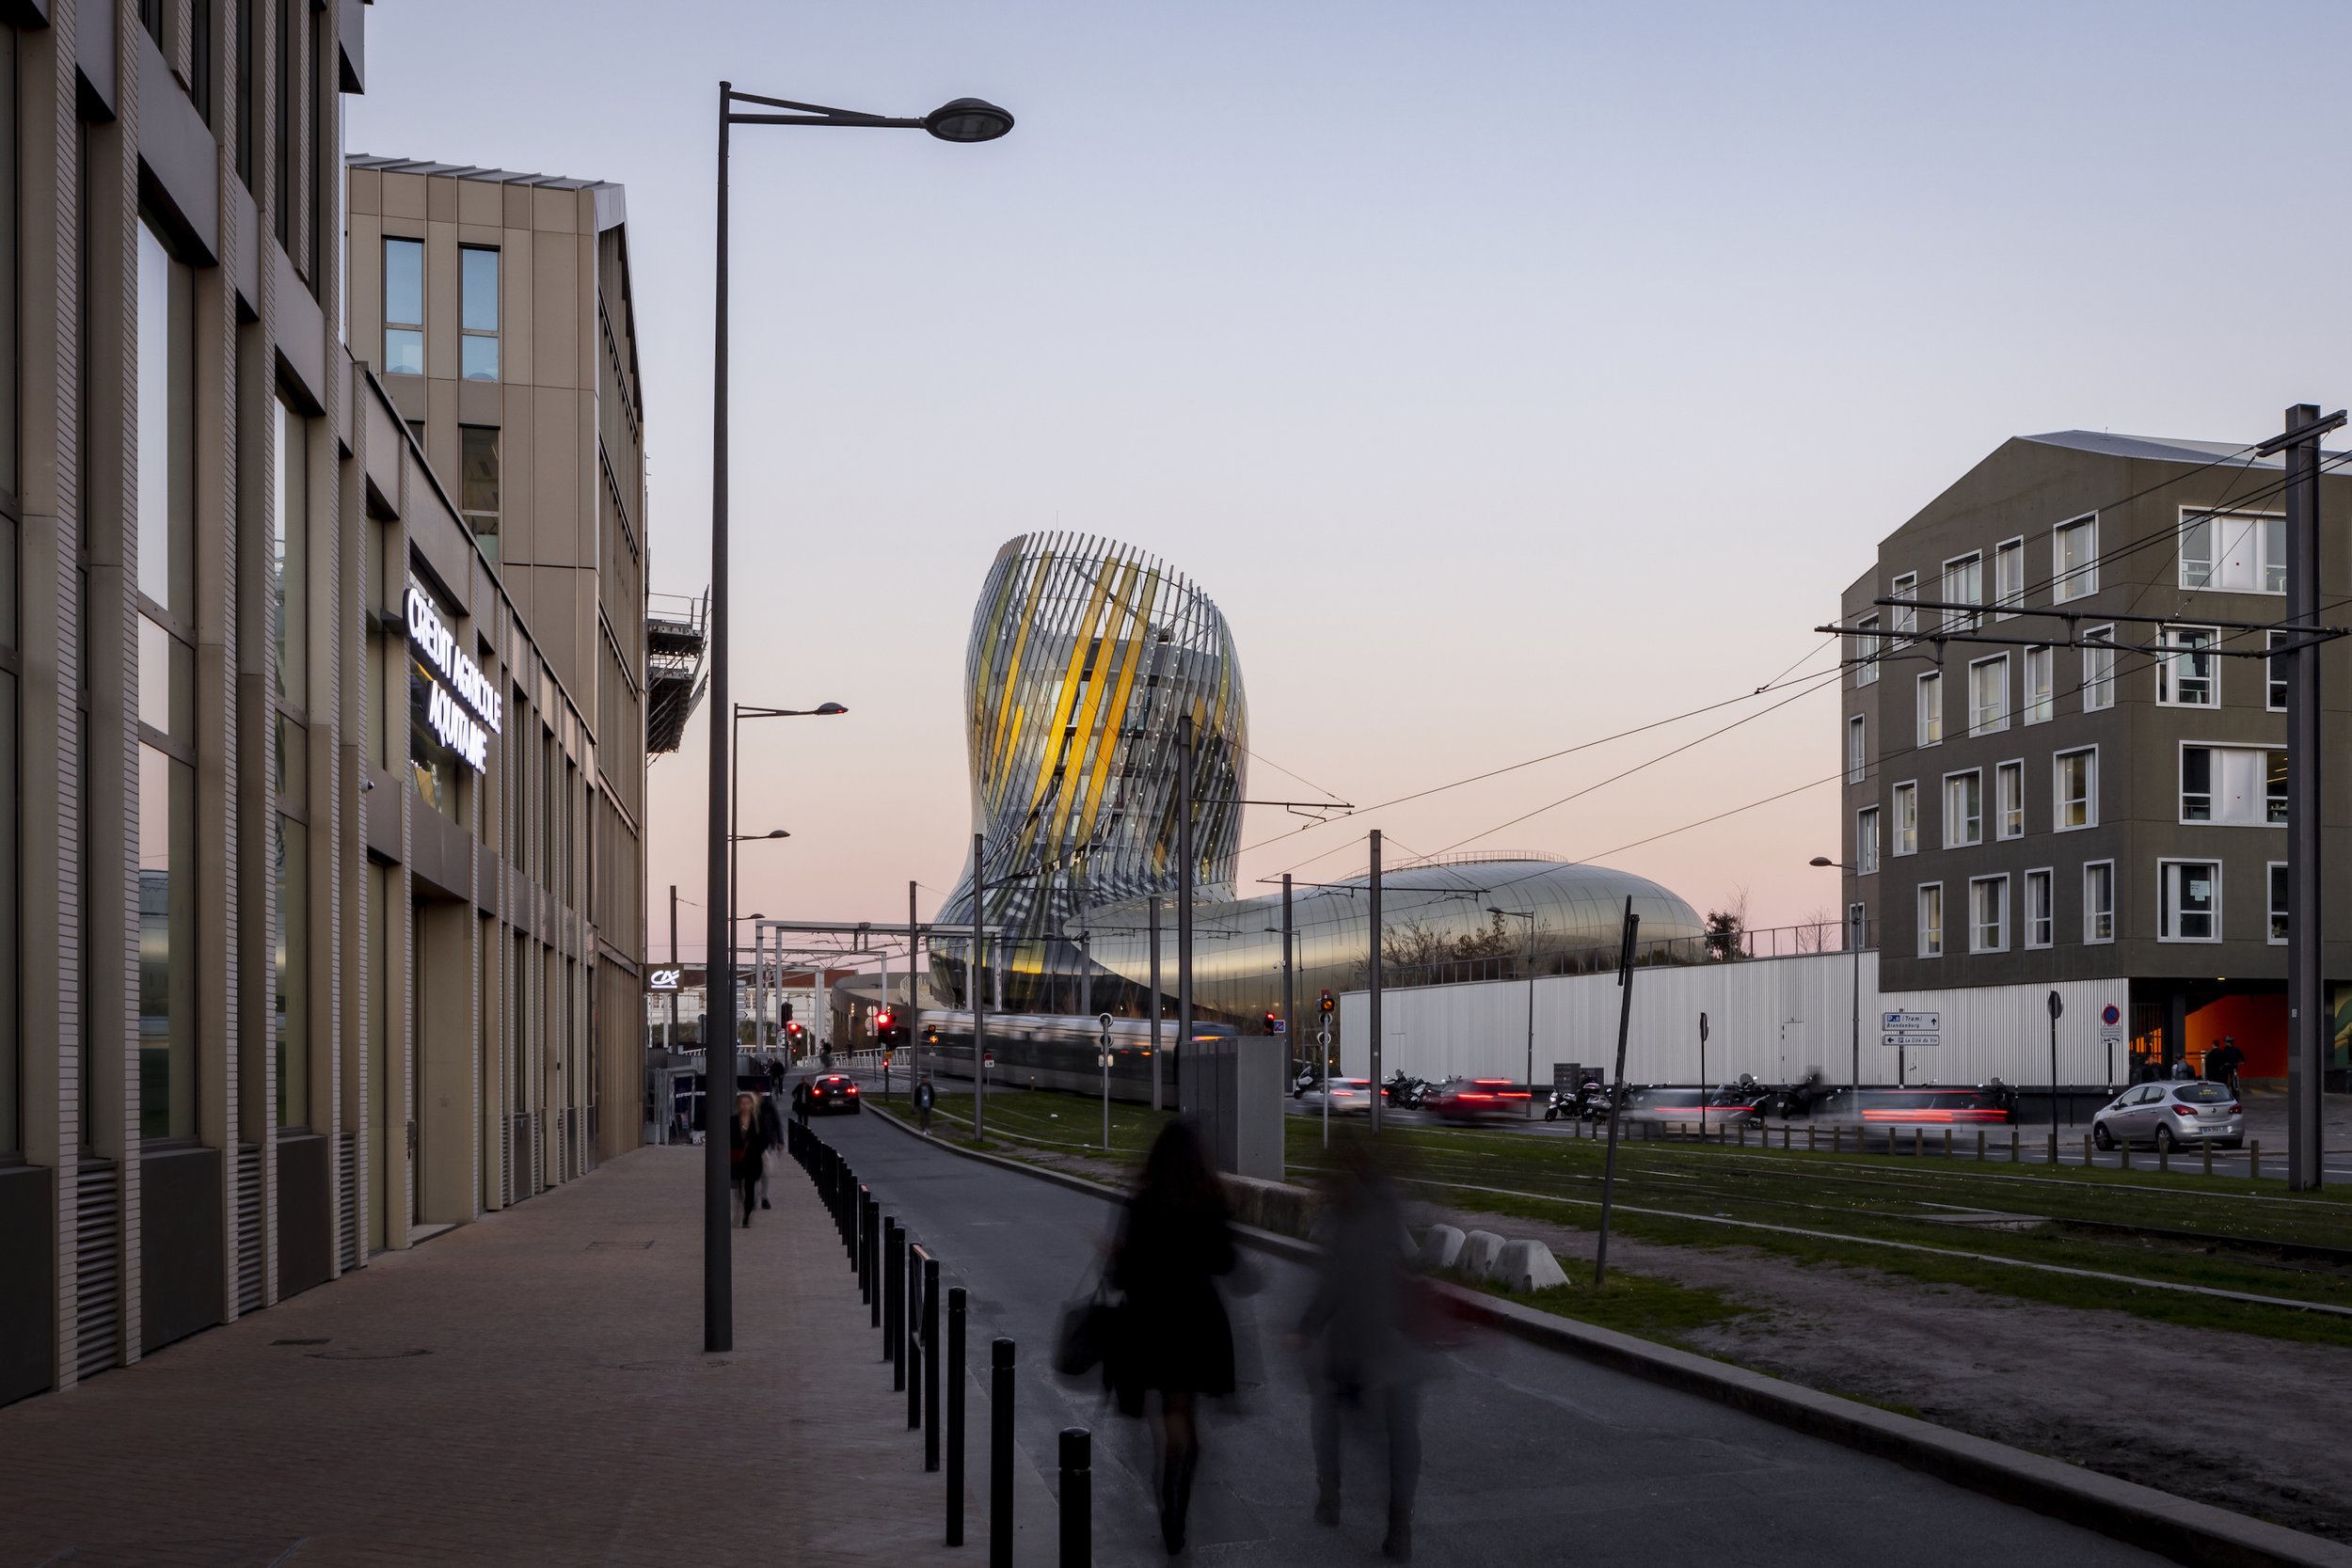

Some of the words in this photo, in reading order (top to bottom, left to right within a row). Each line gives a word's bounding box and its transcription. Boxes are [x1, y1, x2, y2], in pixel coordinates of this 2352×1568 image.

[407, 588, 453, 678] CRÉDIT
[453, 645, 502, 735] AGRICOLE
[429, 680, 487, 775] AQUITAINE
